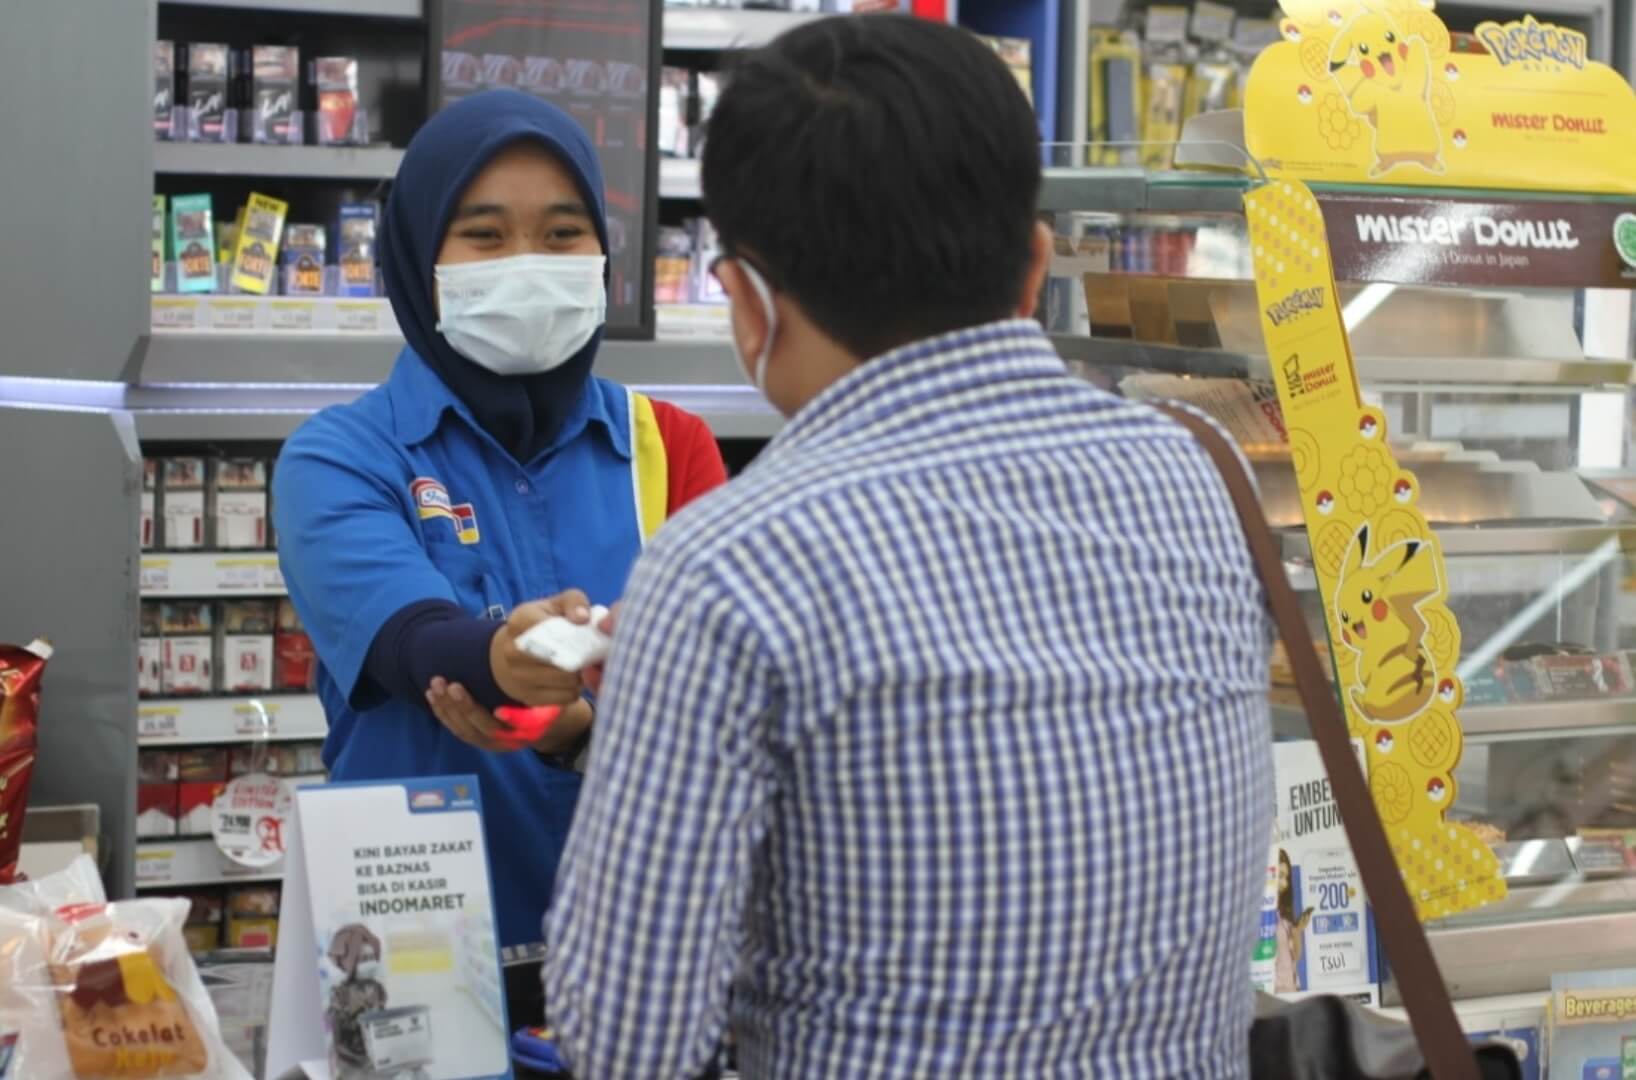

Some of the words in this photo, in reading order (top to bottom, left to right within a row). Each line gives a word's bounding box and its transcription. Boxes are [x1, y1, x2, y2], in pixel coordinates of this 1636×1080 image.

[254, 197, 280, 213] NEW
[1472, 217, 1579, 249] Donut
[1450, 252, 1483, 265] Donut
[1487, 253, 1498, 264] in
[1499, 253, 1529, 268] Japan
[1290, 778, 1334, 811] EMBE
[353, 847, 381, 859] KINI
[384, 844, 427, 858] BAYAR
[430, 840, 473, 855] ZAKAT
[356, 865, 373, 877] KE
[376, 861, 431, 876] BAZNAS
[357, 883, 388, 896] BISA
[391, 881, 405, 893] DI
[407, 878, 447, 891] KASIR
[1318, 882, 1350, 910] 200
[360, 893, 465, 916] INDOMARET
[92, 1021, 185, 1049] Cokelat
